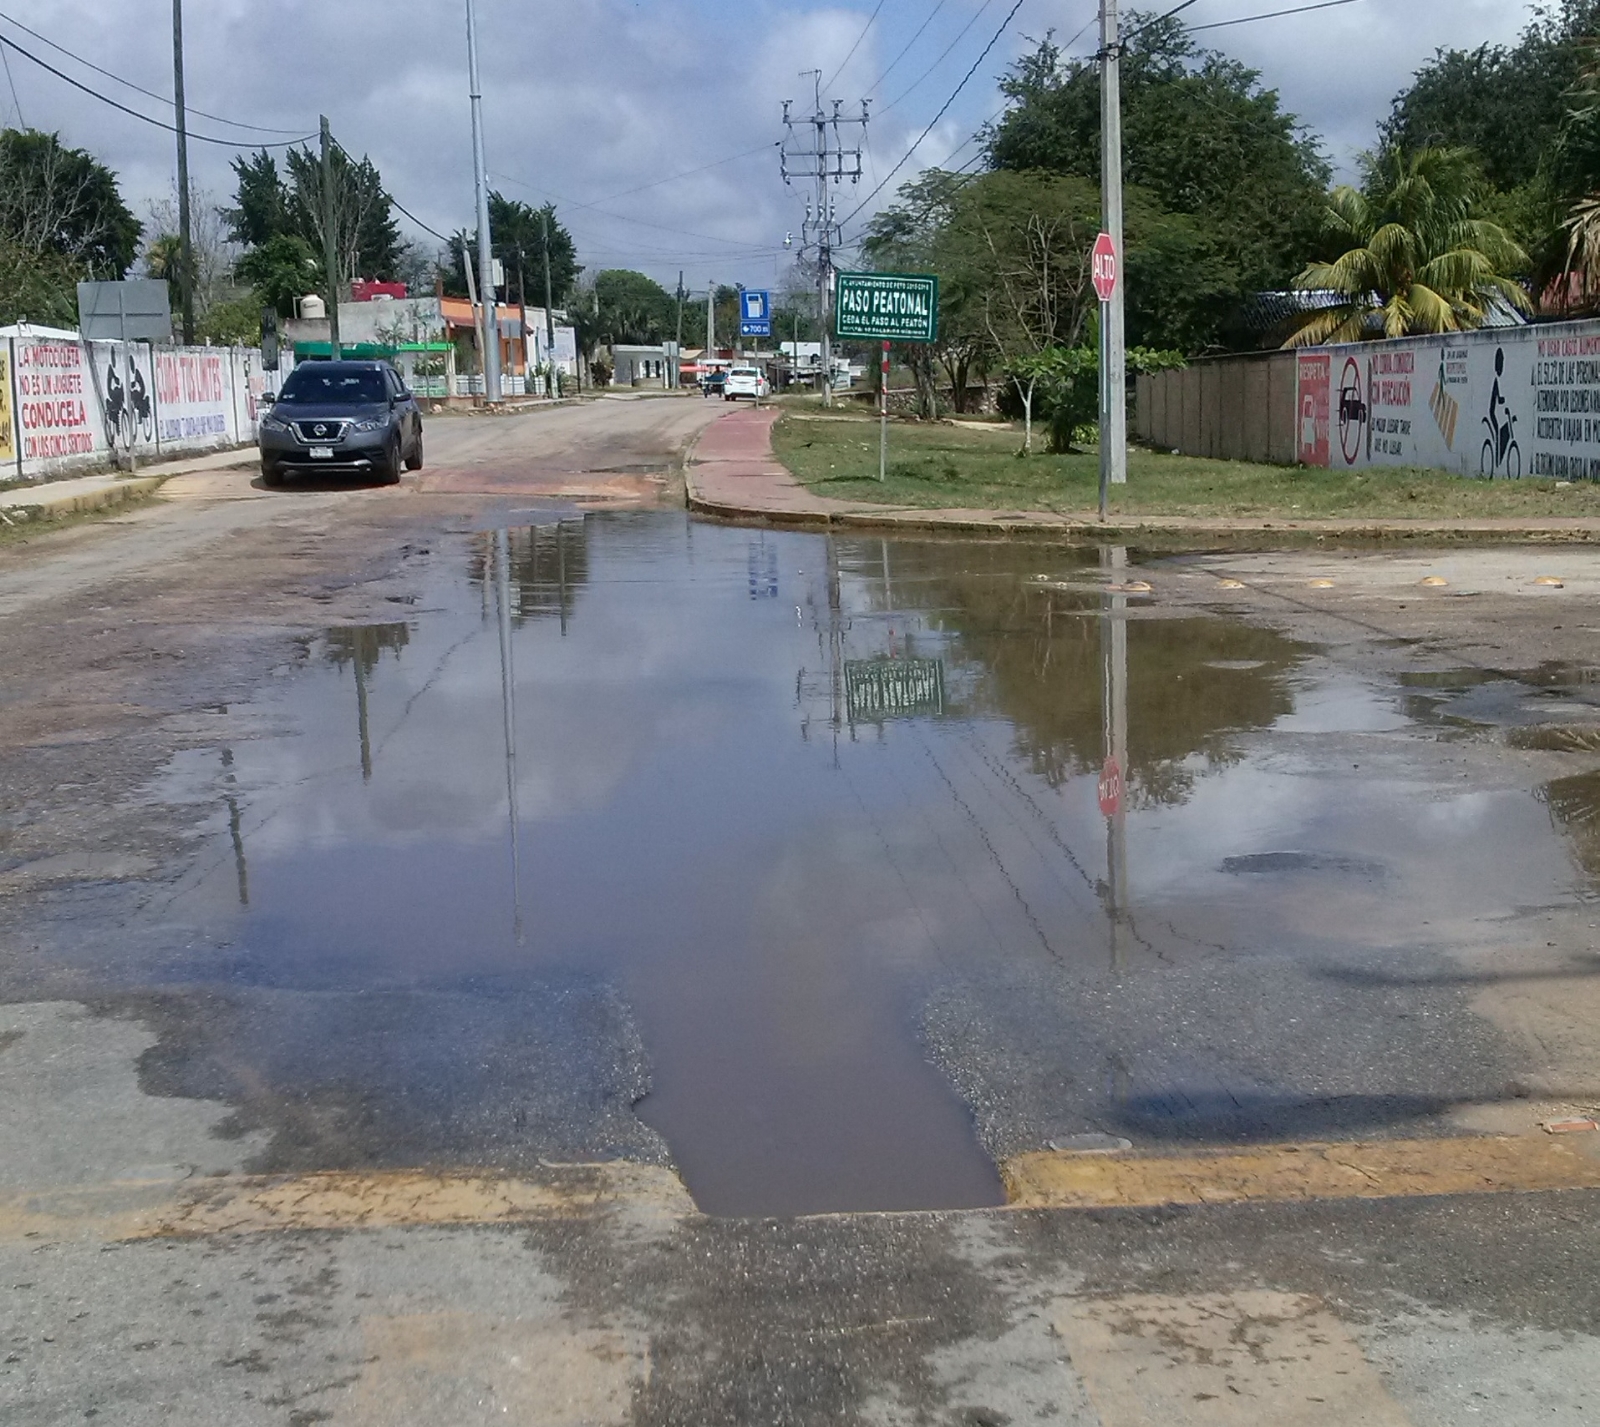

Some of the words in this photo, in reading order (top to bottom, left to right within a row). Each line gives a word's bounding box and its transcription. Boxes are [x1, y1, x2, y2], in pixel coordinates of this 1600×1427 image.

[1093, 254, 1115, 280] ALTO
[849, 280, 886, 288] AYUNTAMIENTO
[842, 289, 870, 312] PASO
[873, 290, 928, 316] PEATONAL
[749, 325, 762, 333] 700
[842, 314, 860, 324] CEDA
[861, 315, 870, 325] EL
[871, 316, 889, 326] PASO
[890, 317, 899, 327] AL
[901, 316, 928, 328] PEATÓN
[18, 346, 30, 367] LA
[33, 346, 80, 367] MOTOCICLETA
[1537, 340, 1546, 357] NO
[1547, 340, 1560, 356] USAR
[1562, 339, 1578, 356] CASCO
[1300, 362, 1326, 380] RESPETA
[1537, 361, 1543, 385] EL
[1559, 361, 1565, 385] DE
[1566, 361, 1575, 385] LAS
[19, 374, 30, 395] NO
[32, 374, 40, 395] ES
[42, 374, 53, 395] UN
[54, 373, 83, 394] JUGUETE
[22, 400, 87, 429] CONDUCELA
[25, 437, 37, 458] CON
[38, 436, 50, 457] LOS
[51, 435, 68, 456] CINCO
[68, 432, 93, 454] SENTIDOS
